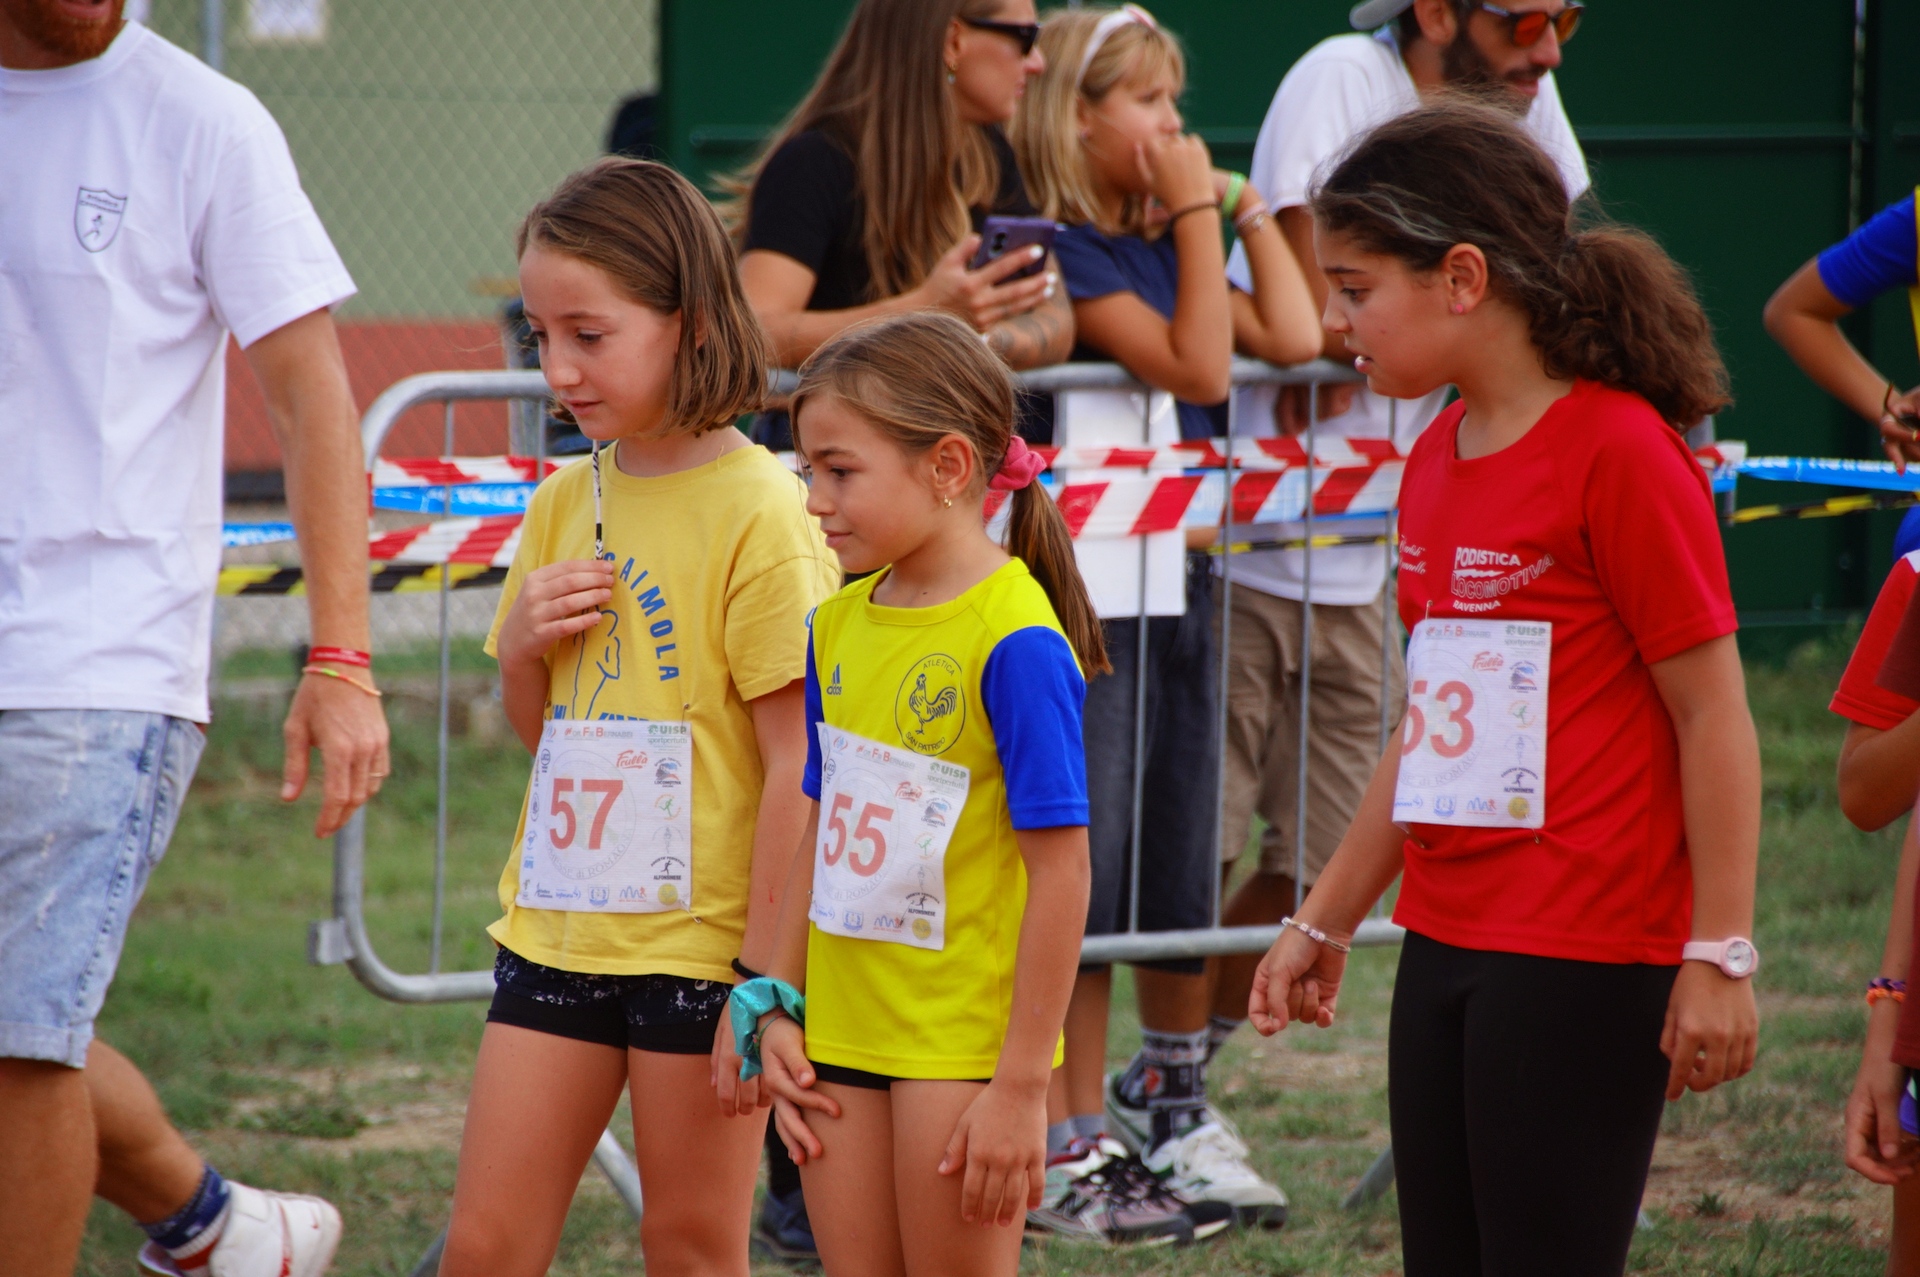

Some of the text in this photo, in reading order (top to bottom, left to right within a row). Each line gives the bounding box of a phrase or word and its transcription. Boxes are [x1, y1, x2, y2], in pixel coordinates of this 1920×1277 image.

[1455, 547, 1521, 569] PODISTICA
[1451, 553, 1554, 599] LOCOMOTIVA
[1453, 600, 1501, 612] RAVENNA
[1517, 626, 1546, 636] UISP
[923, 658, 955, 677] ATLETICA
[1402, 680, 1474, 758] 53
[659, 725, 687, 735] UISP
[905, 731, 918, 747] SAN
[941, 765, 967, 779] UISP
[550, 777, 623, 850] 57
[823, 793, 893, 877] 55
